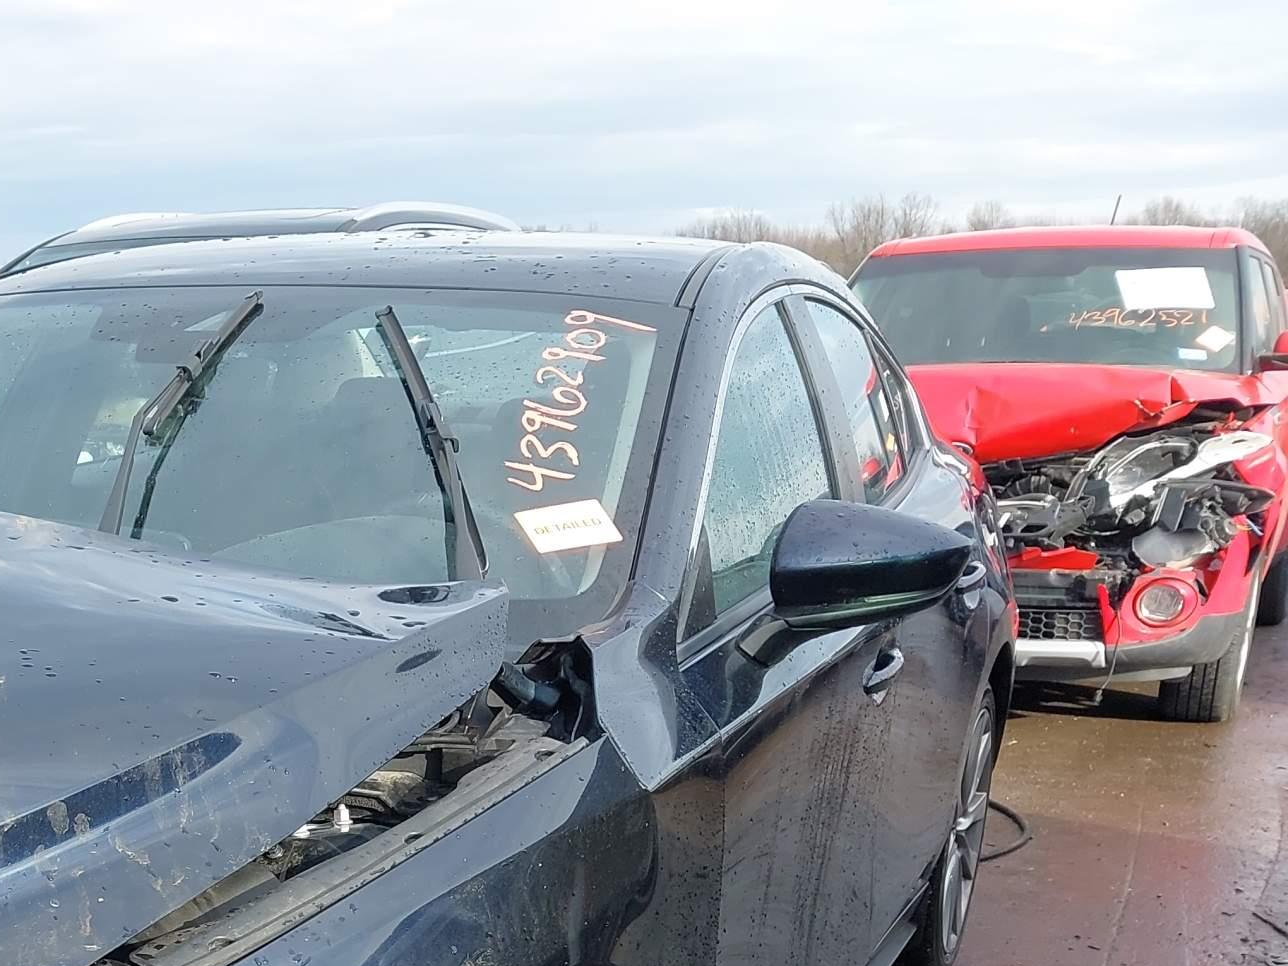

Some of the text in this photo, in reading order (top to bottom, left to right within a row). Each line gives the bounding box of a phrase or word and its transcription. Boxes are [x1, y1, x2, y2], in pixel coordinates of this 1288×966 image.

[1068, 307, 1208, 331] 43962521
[504, 309, 658, 492] 43962909
[533, 517, 602, 535] DETAILED
